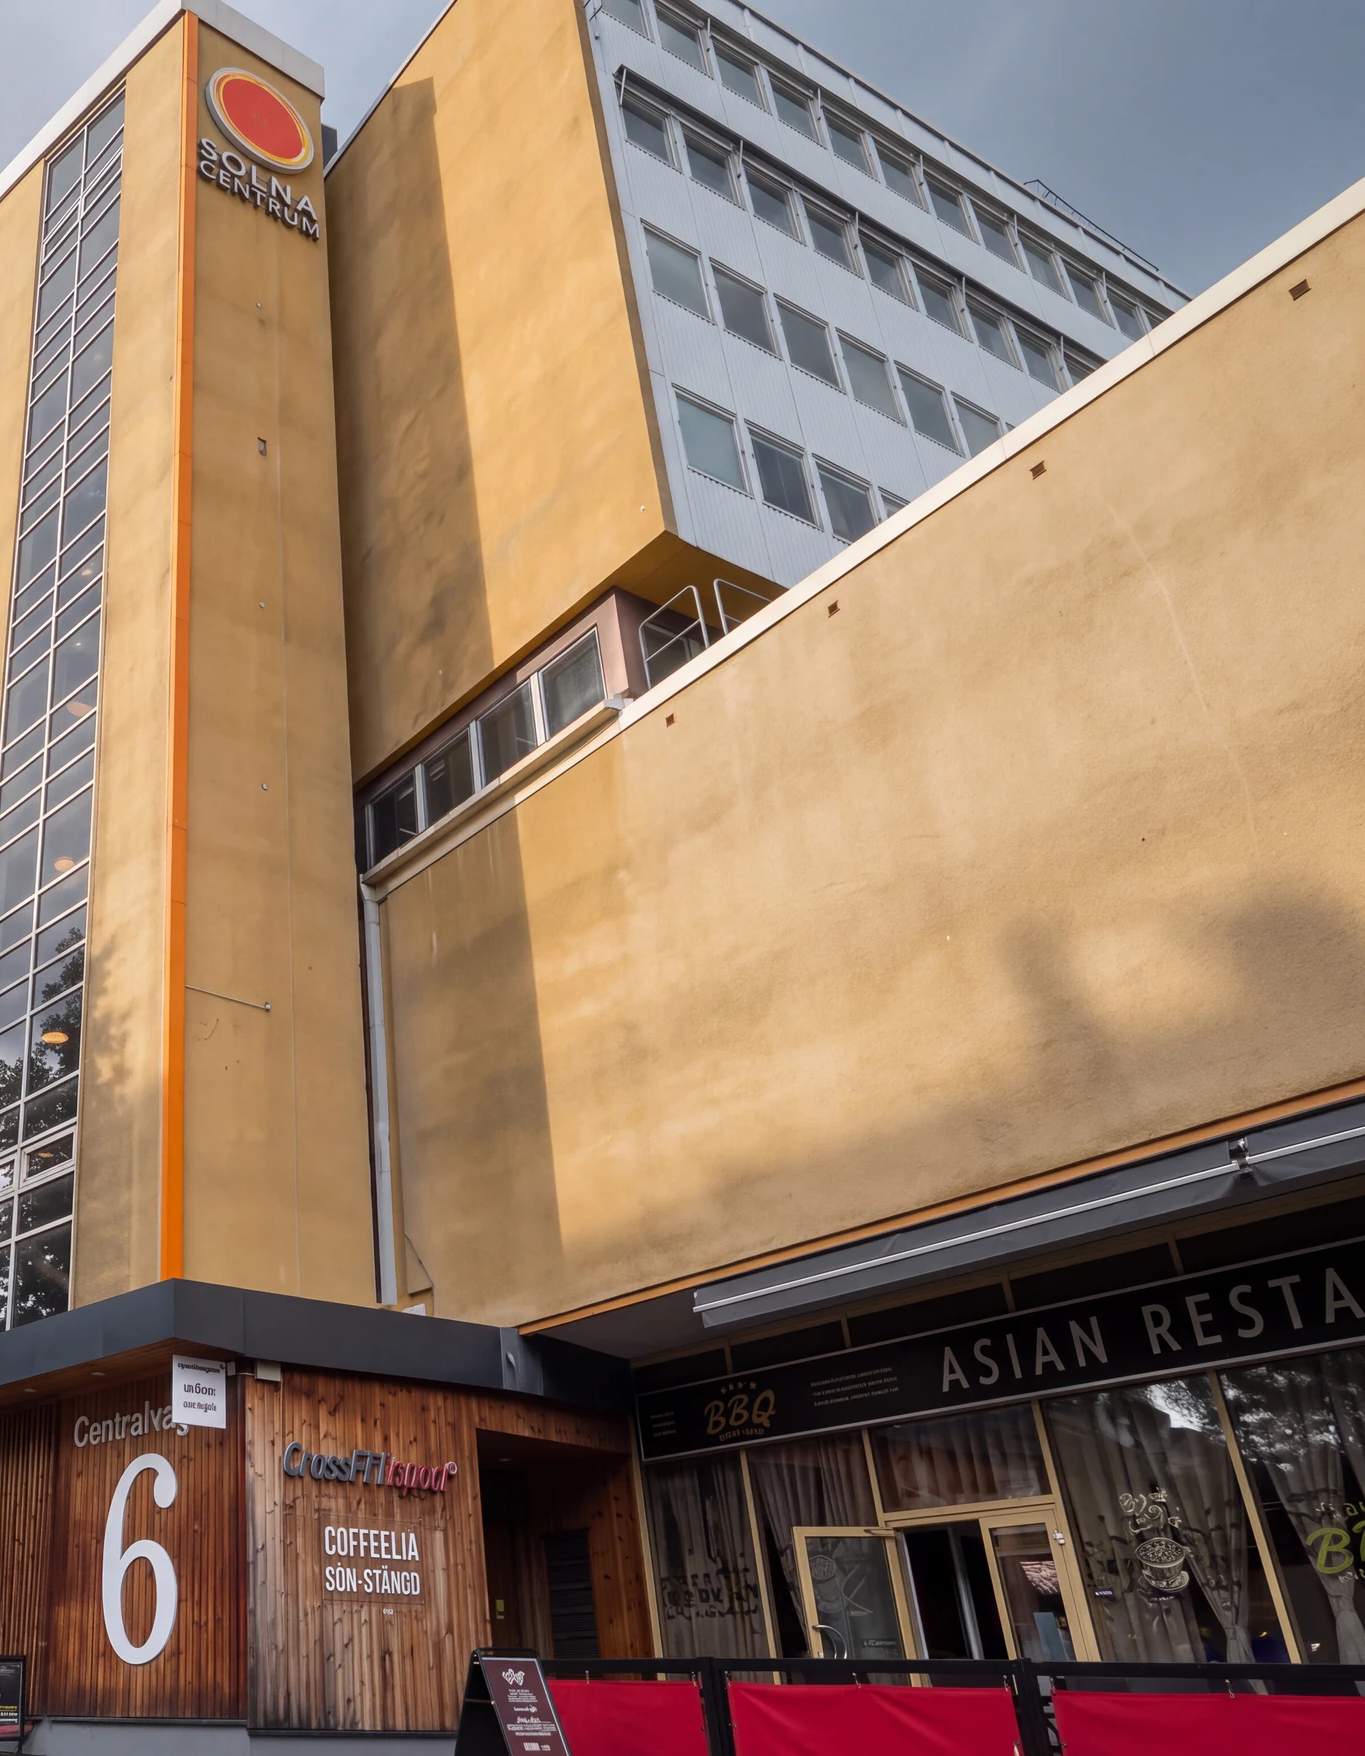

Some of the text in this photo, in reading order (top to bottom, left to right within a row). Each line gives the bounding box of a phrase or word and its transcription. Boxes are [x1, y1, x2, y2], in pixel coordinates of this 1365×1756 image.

[199, 160, 320, 240] CENTRUM
[200, 137, 318, 221] SOLNA
[941, 1316, 1108, 1393] ASIAN
[1141, 1267, 1365, 1355] RESTA
[703, 1389, 776, 1435] BBQ
[102, 1453, 178, 1665] 6
[324, 1526, 420, 1561] COFFEELIA
